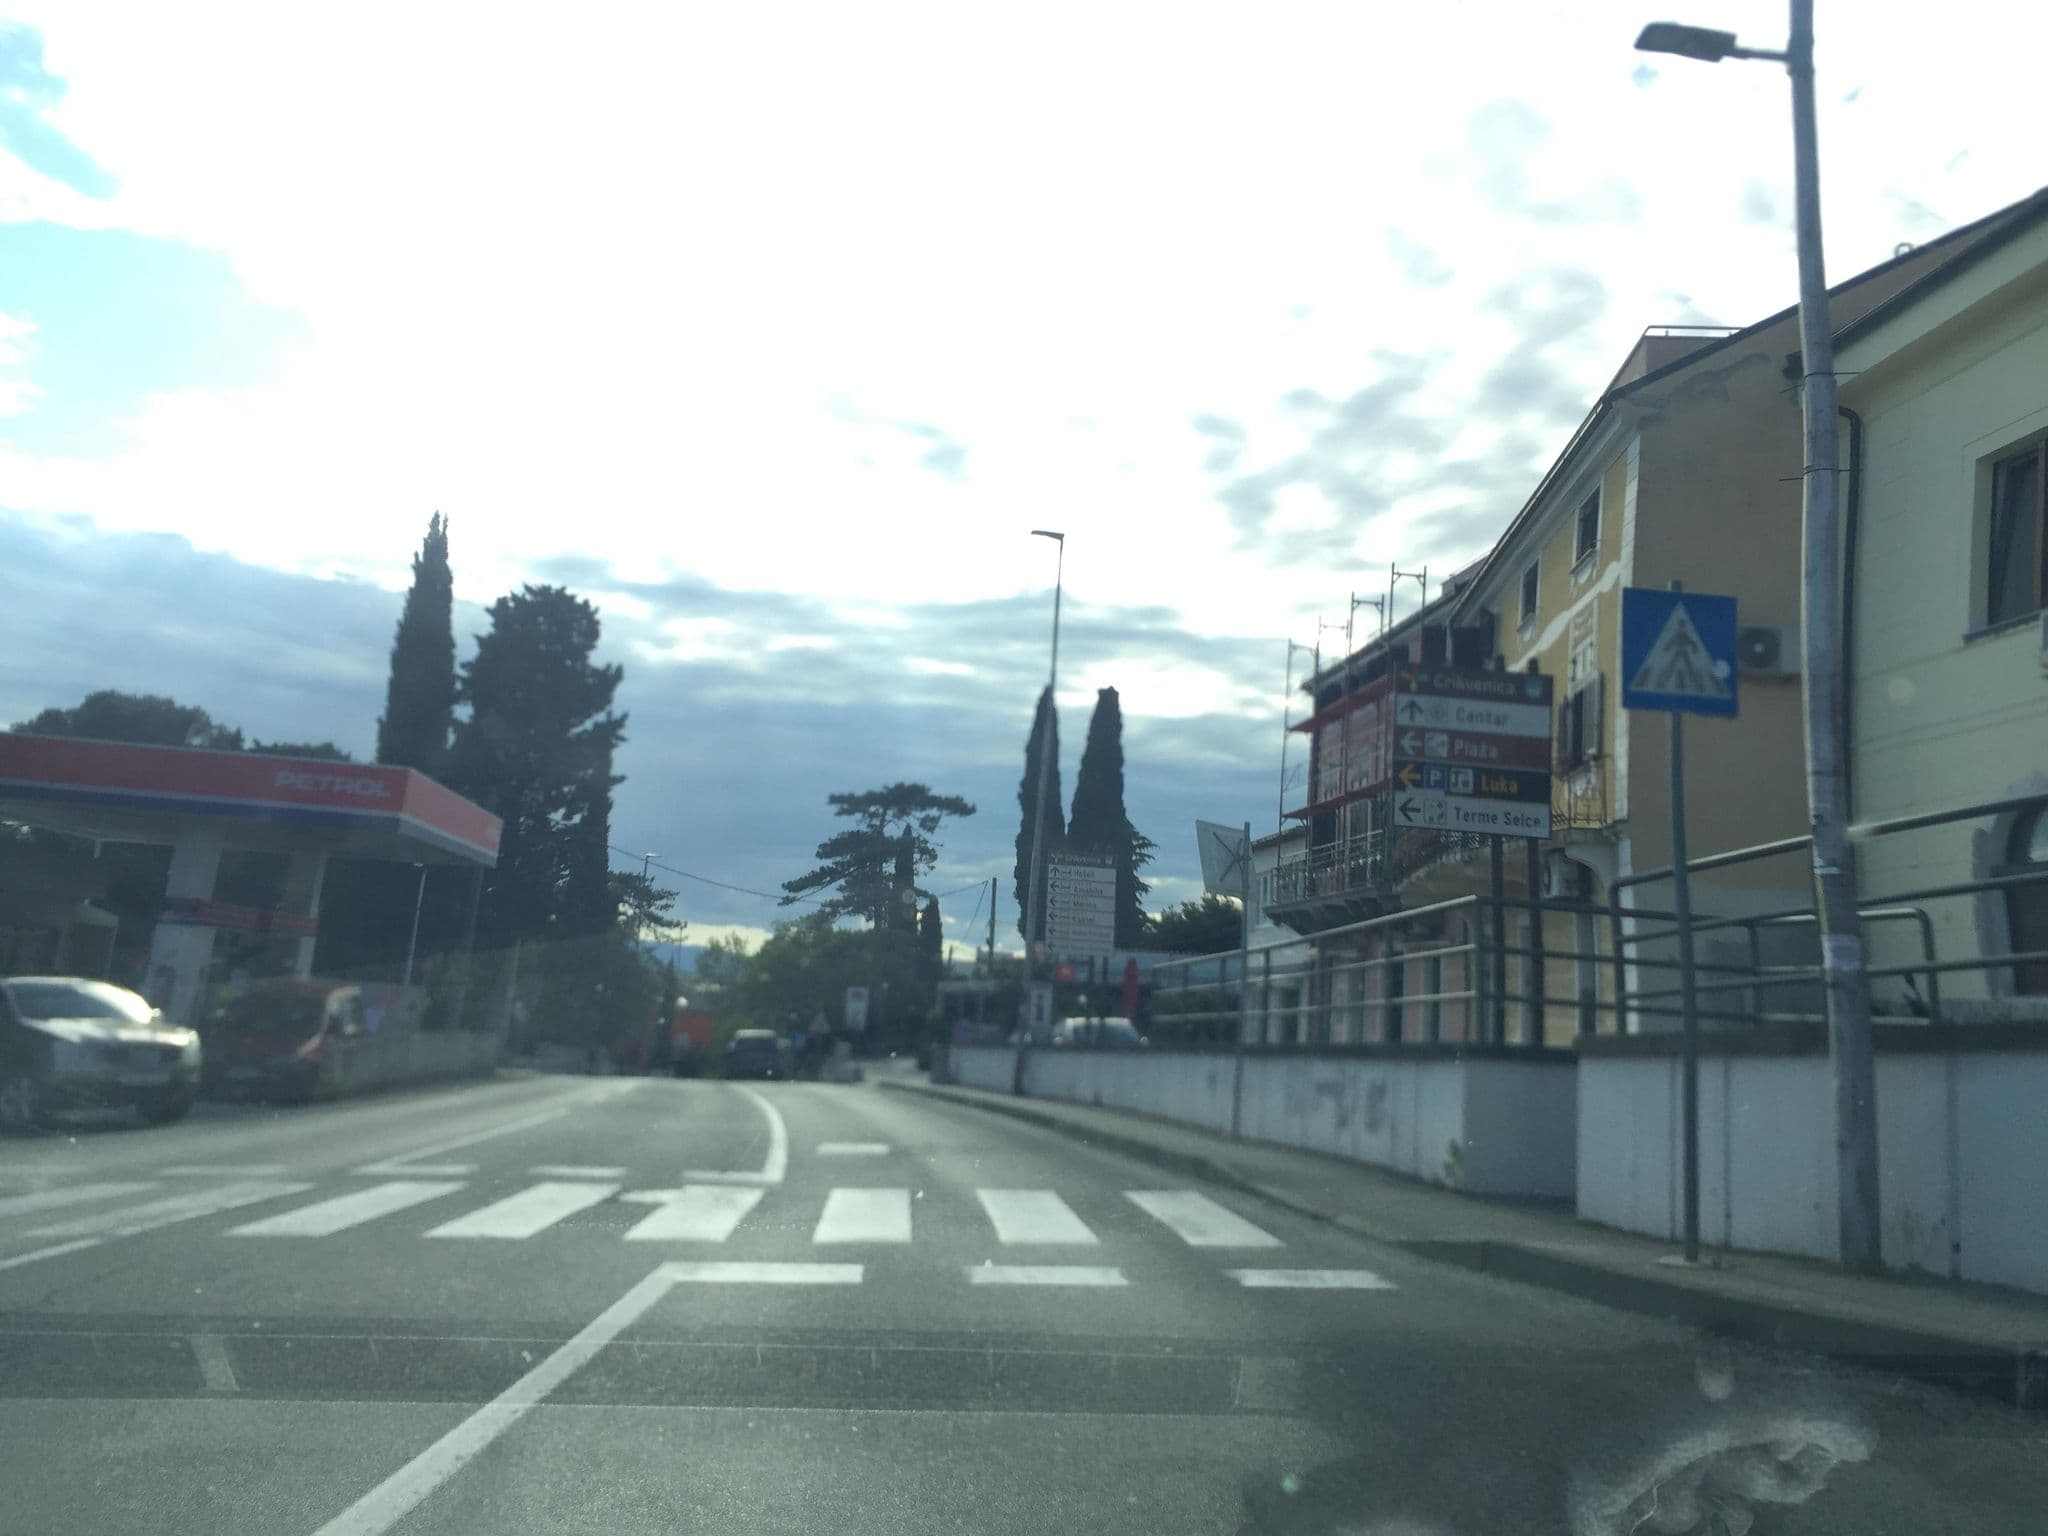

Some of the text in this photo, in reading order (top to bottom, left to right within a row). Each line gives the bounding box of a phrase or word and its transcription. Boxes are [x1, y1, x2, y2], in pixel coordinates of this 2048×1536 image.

[275, 770, 391, 797] PETROL
[1482, 773, 1518, 795] Luka
[1455, 807, 1498, 825] Terme
